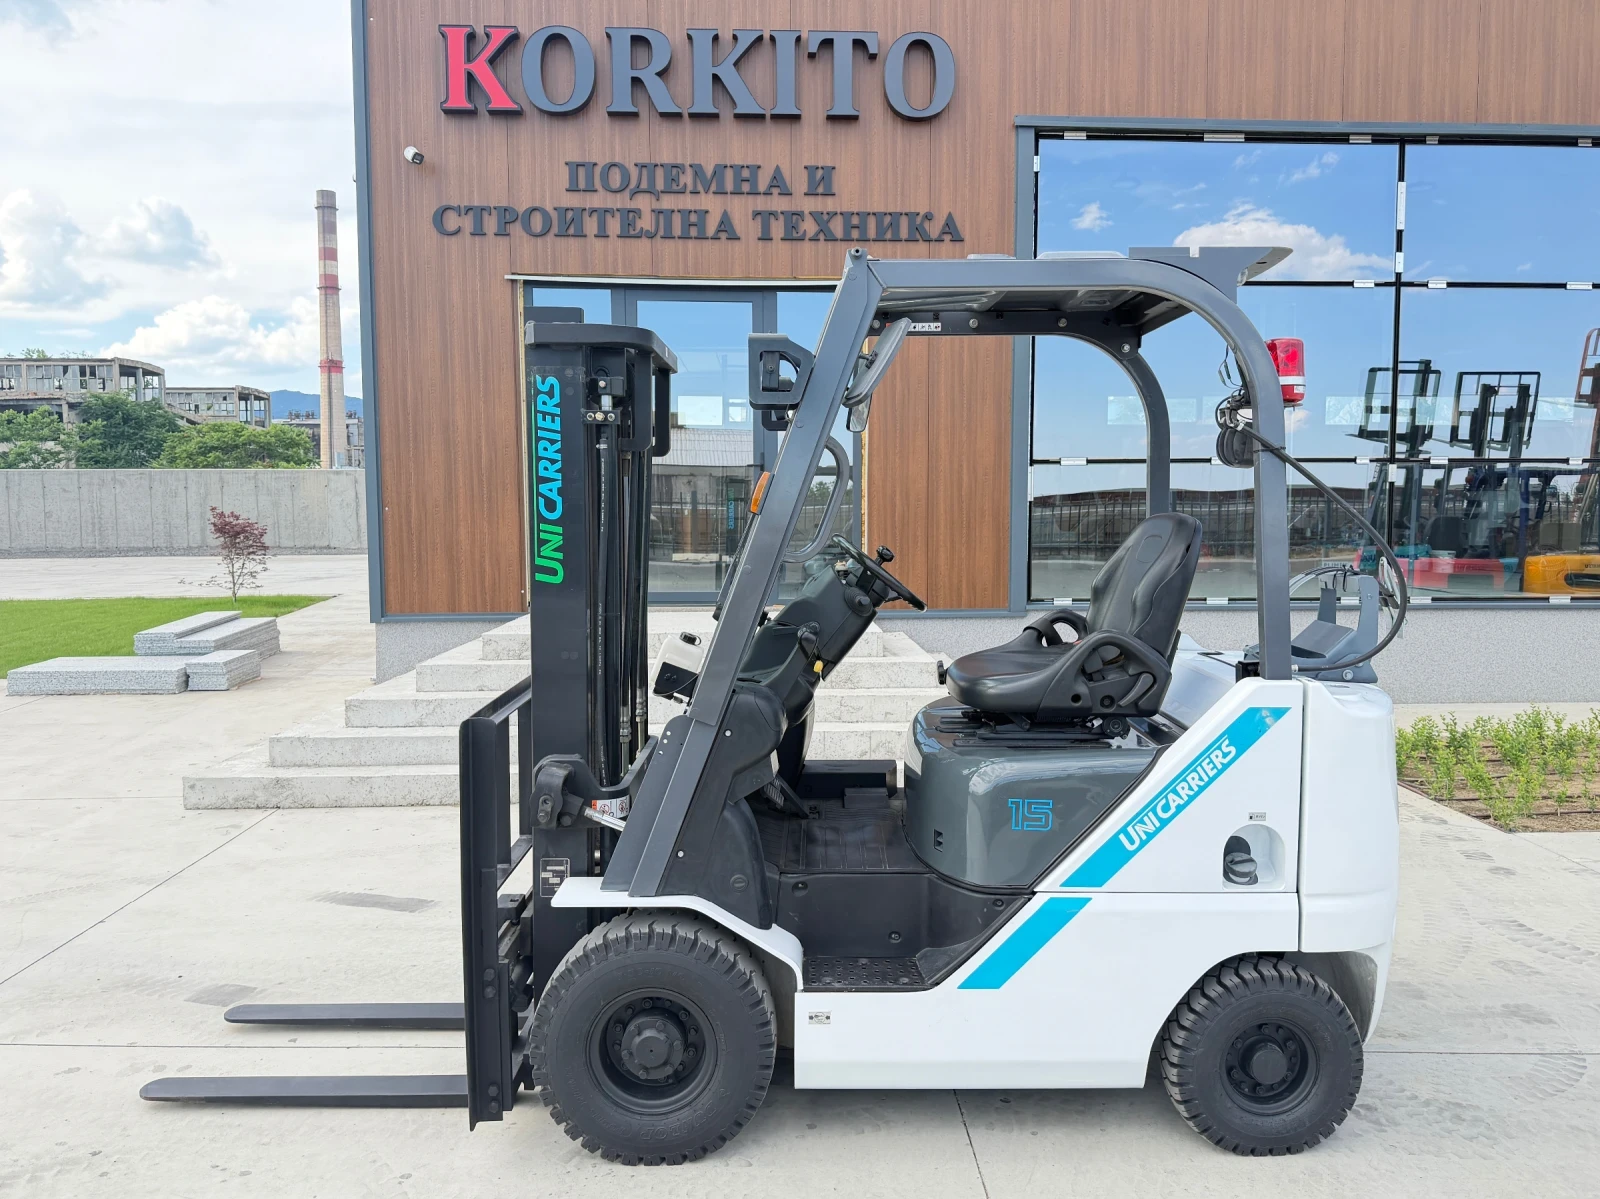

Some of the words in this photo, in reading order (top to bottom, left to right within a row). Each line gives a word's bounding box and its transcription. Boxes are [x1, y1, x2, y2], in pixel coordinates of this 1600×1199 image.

[438, 24, 956, 122] KORKITO
[565, 160, 793, 200] ПОДЕМНА
[804, 164, 836, 196] И
[432, 204, 740, 240] СТРОИТЕЛНА
[752, 209, 964, 242] ТЕХНИКА
[1008, 798, 1053, 831] 15
